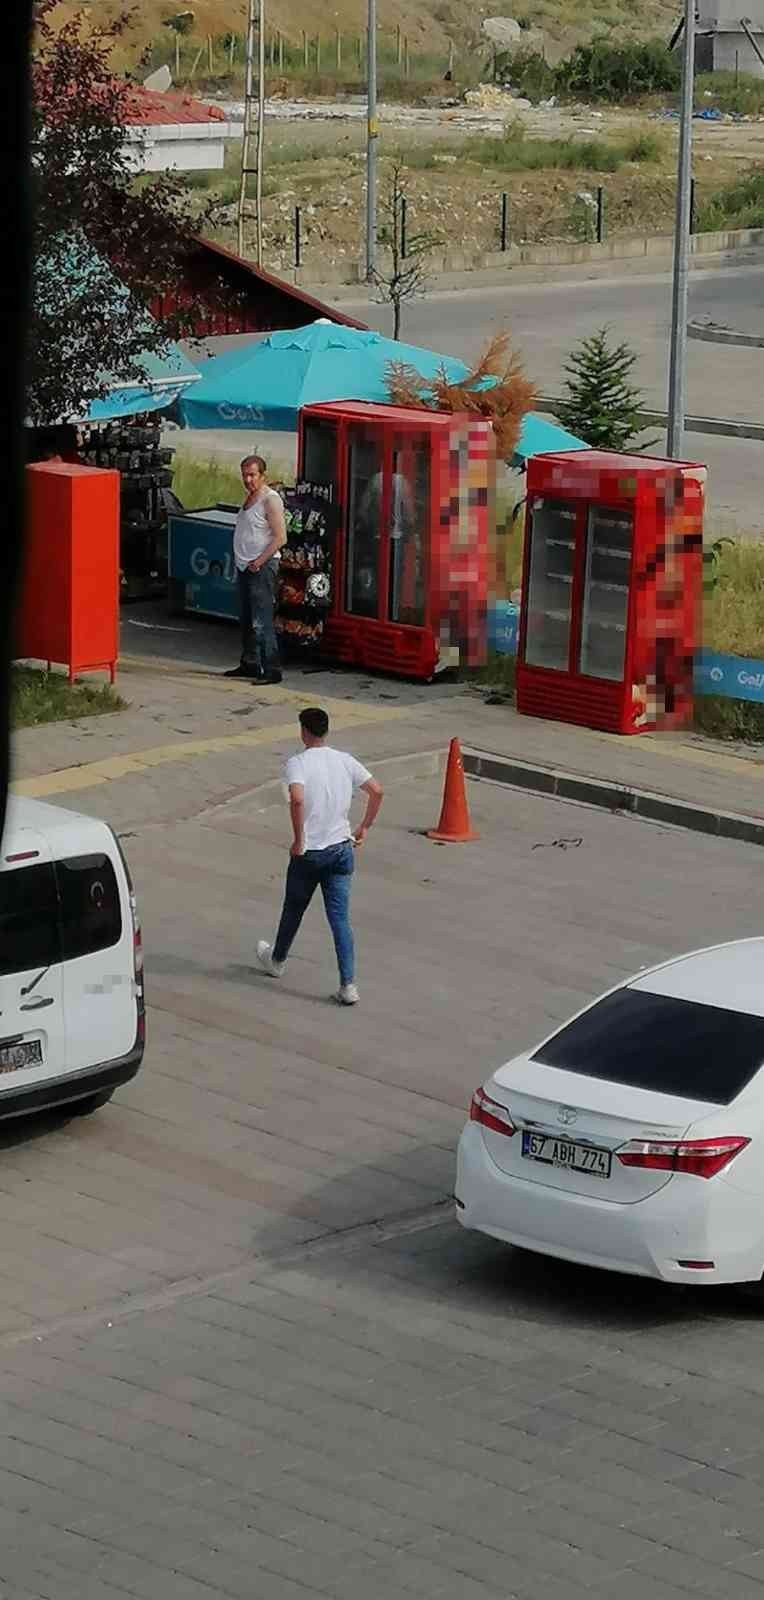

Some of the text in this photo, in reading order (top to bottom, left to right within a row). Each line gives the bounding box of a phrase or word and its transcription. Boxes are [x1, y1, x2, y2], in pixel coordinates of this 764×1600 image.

[191, 547, 238, 583] Gol
[530, 1135, 546, 1155] 67
[552, 1142, 576, 1164] ABH
[582, 1149, 605, 1171] 774
